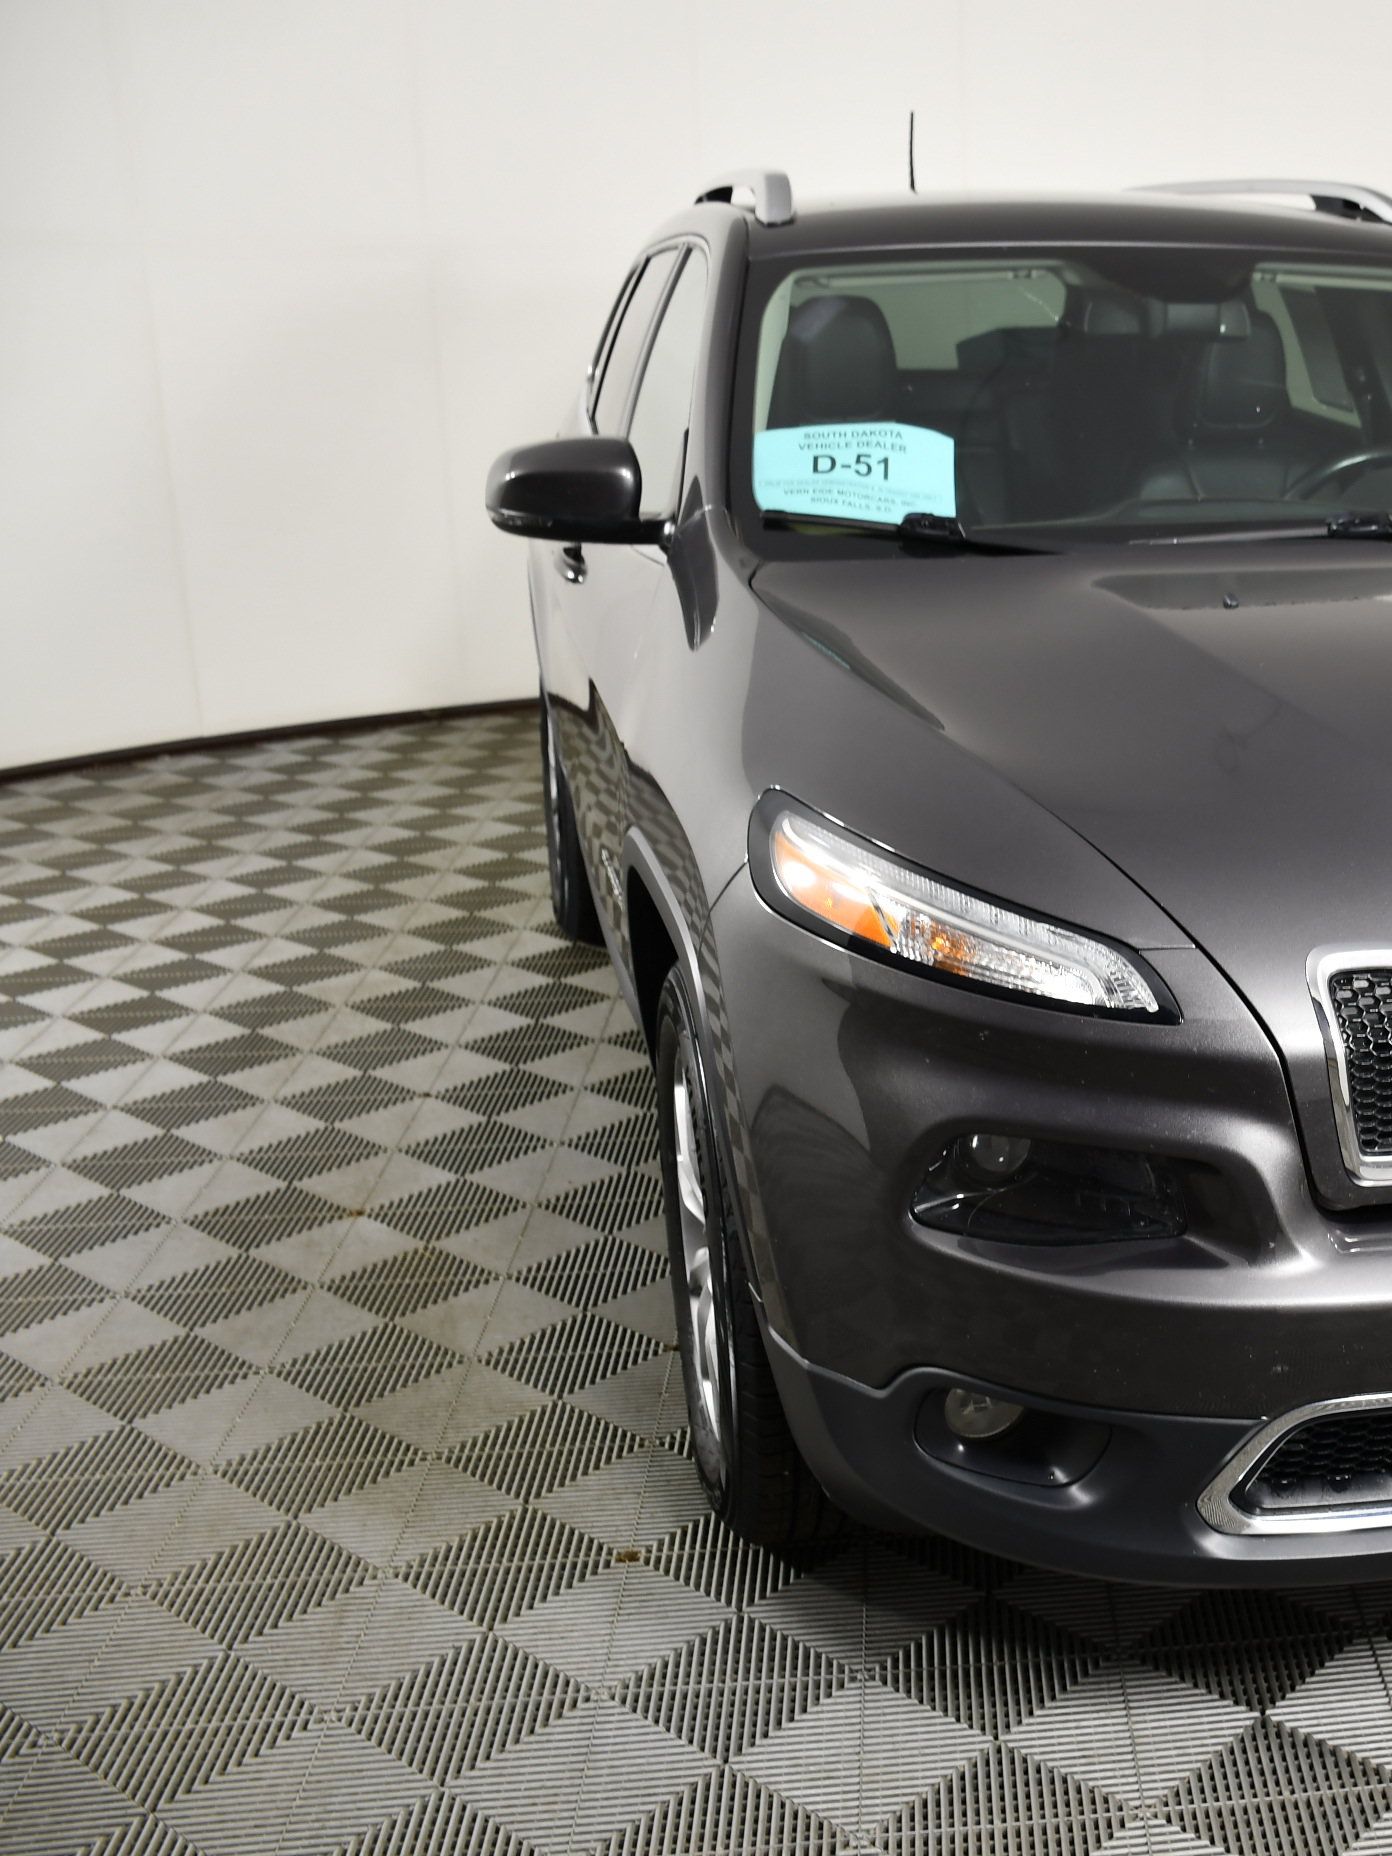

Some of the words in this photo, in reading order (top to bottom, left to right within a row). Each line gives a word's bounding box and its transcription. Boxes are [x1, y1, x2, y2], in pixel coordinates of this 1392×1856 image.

[804, 430, 847, 440] SOUTH
[851, 429, 903, 440] DAKOTA
[798, 440, 852, 451] VEHICLE
[857, 440, 907, 454] DEALER
[812, 453, 889, 481] D-51
